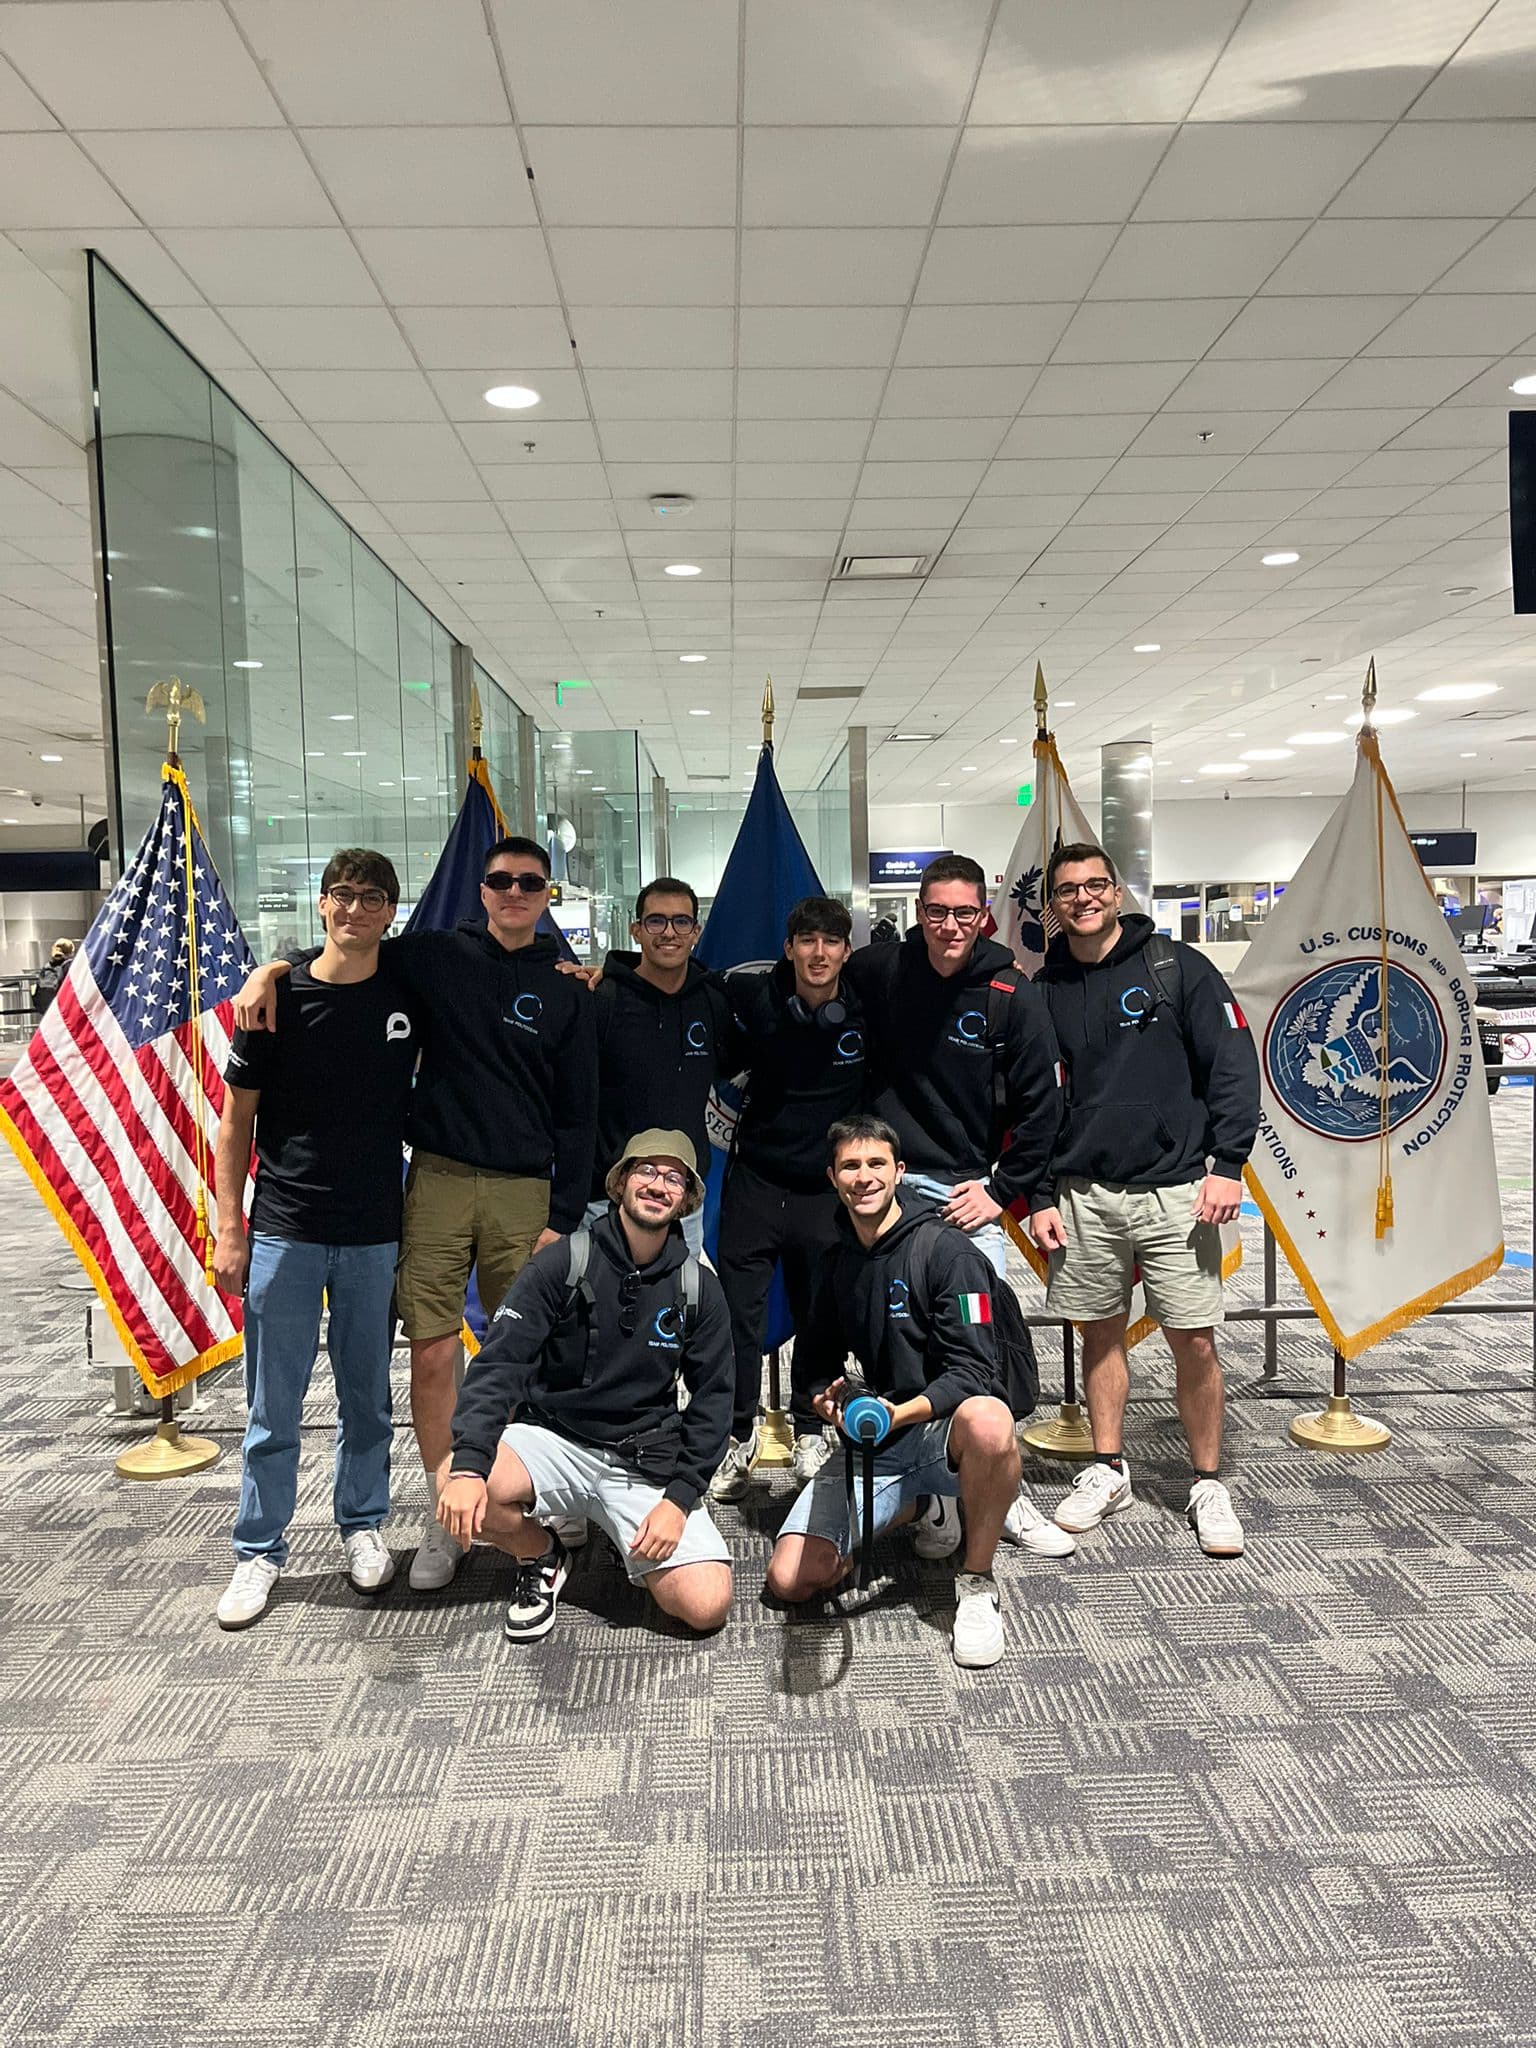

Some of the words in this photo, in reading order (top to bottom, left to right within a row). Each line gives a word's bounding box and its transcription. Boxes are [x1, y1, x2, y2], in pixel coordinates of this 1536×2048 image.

[1299, 931, 1341, 954] U.S.
[1347, 926, 1429, 956] CUSTOMS
[1429, 957, 1447, 976] AND
[1448, 978, 1473, 1047] BORDER
[1402, 1053, 1473, 1156] PROTECTION
[1259, 1107, 1298, 1180] RATIONS
